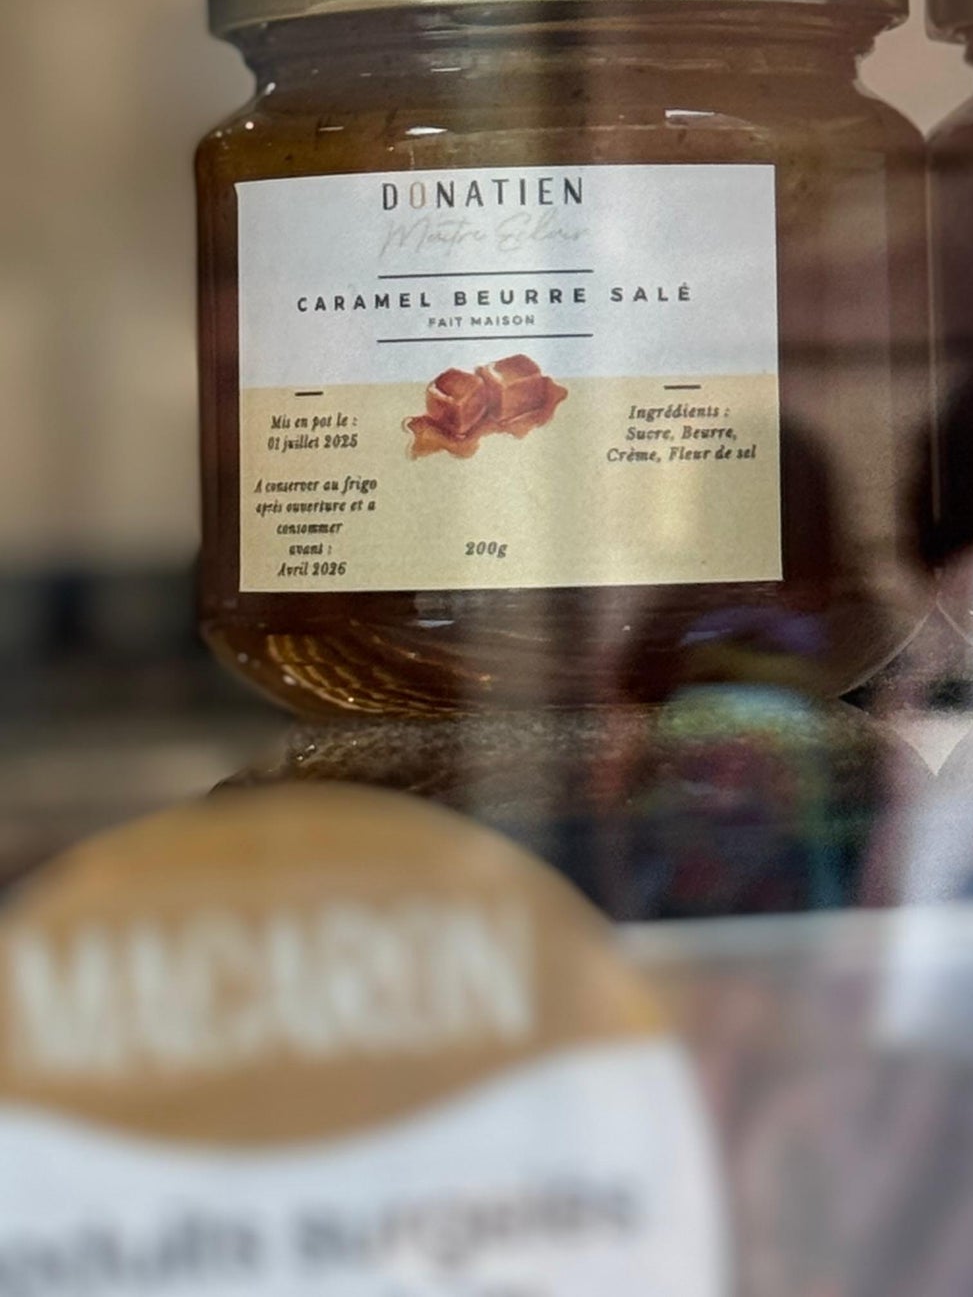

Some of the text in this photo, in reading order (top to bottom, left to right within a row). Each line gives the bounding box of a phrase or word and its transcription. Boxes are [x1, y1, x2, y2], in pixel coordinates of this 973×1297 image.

[382, 176, 583, 210] DONATIEN
[296, 282, 692, 312] CARAMEL BEURRE SALÉ
[428, 313, 536, 328] FAIT MAISON
[270, 414, 291, 430] Mis
[294, 416, 308, 428] en
[311, 414, 333, 432] pot
[336, 412, 349, 427] le
[628, 404, 720, 422] Ingrédients
[625, 425, 738, 442] Sucre, Beurre,
[267, 433, 358, 453] 01 juillet 2025
[606, 444, 757, 463] Crème, Fleur de sel
[265, 479, 320, 493] conserver
[322, 480, 339, 492] au
[341, 475, 378, 496] frigo
[255, 499, 283, 517] après
[286, 499, 346, 513] ouverture
[350, 499, 363, 512] et
[276, 522, 343, 535] consommer
[288, 542, 324, 555] avant
[465, 540, 508, 559] 200g
[277, 560, 348, 577] Avril 2026
